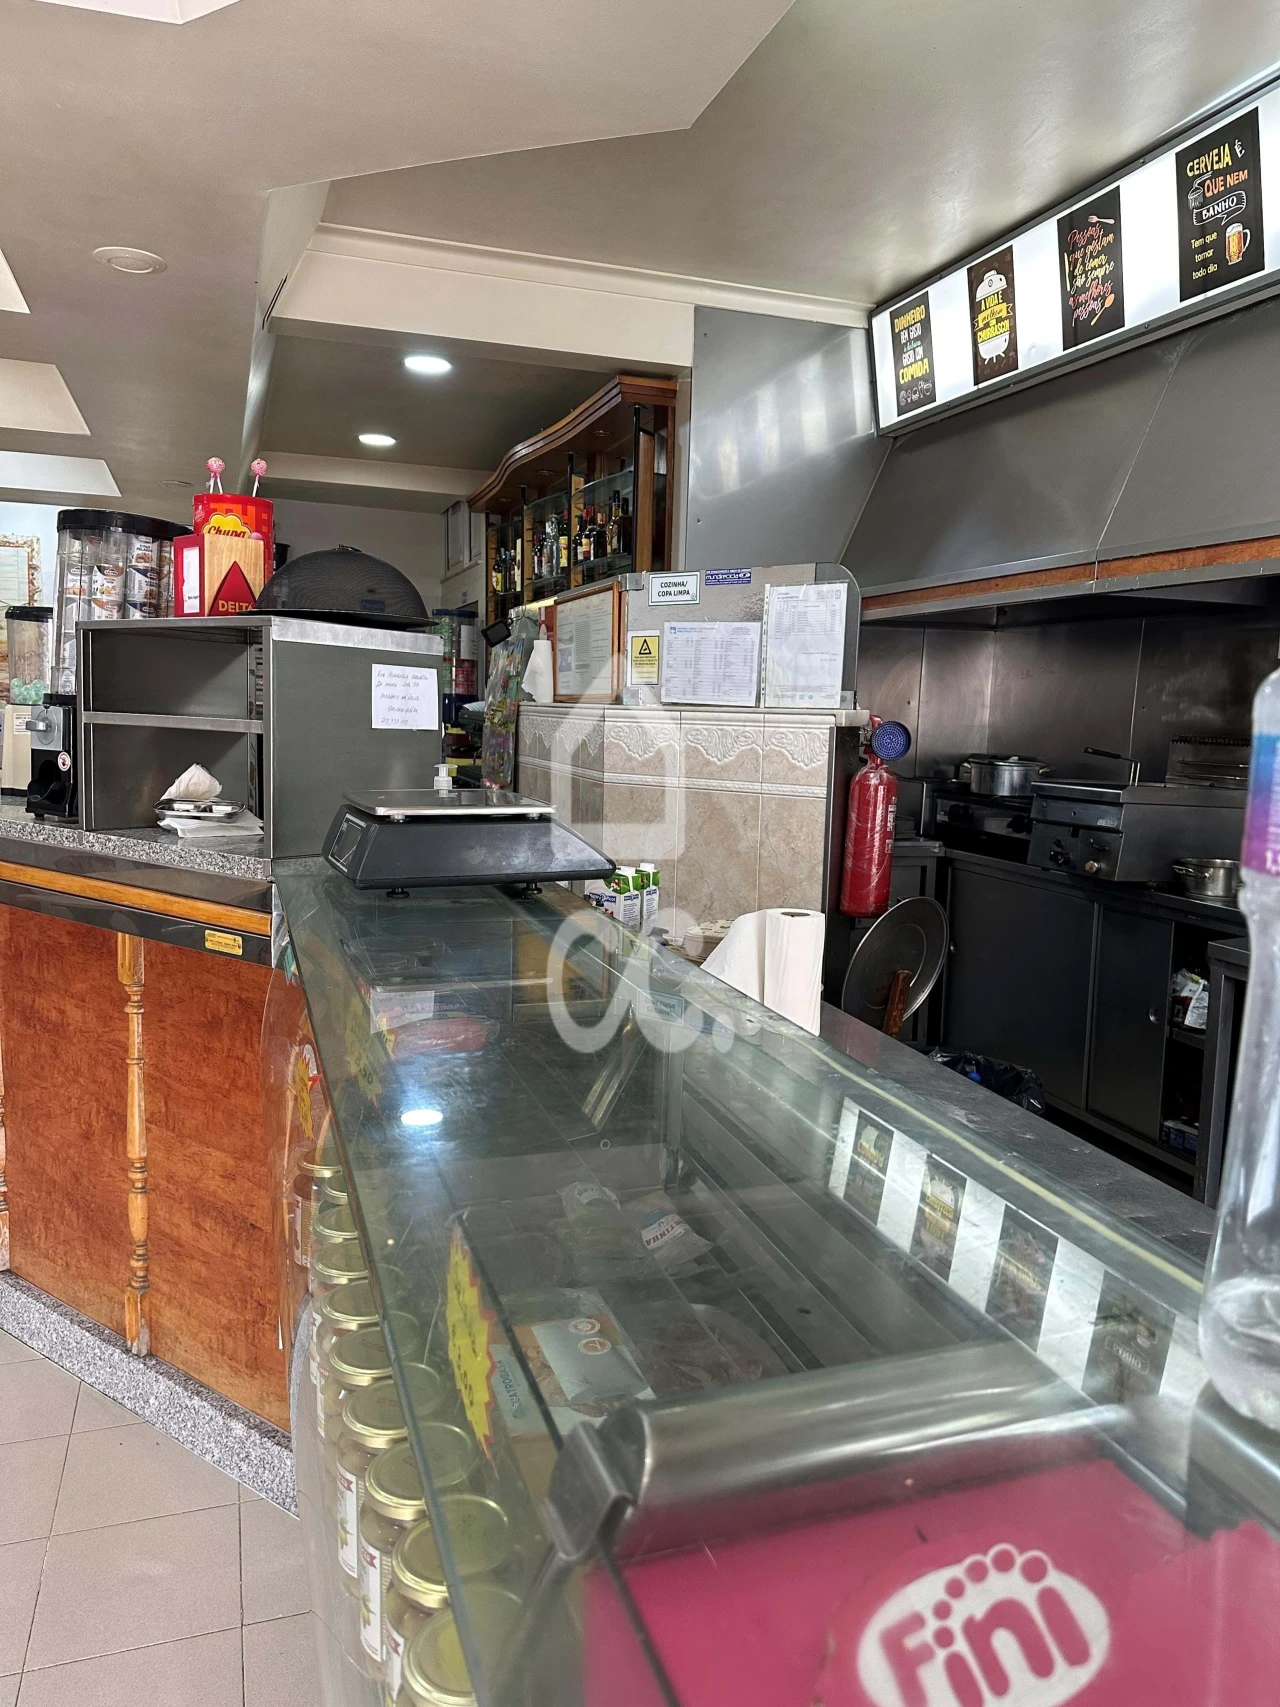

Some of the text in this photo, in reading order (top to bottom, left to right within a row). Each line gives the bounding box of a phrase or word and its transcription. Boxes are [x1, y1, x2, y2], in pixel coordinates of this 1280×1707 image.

[1186, 139, 1245, 178] CERVEJA É
[1204, 169, 1248, 198] QUE NEM
[1202, 195, 1236, 220] BANHO
[1068, 223, 1102, 250] Pessoas
[1190, 231, 1218, 249] Tem que
[1069, 229, 1115, 271] que gostam
[1194, 248, 1214, 262] tomar
[1074, 253, 1108, 276] de comer
[1086, 260, 1115, 288] sempre
[1192, 262, 1218, 279] todo dia
[981, 299, 986, 311] A
[985, 293, 999, 309] VIDA
[1079, 279, 1113, 302] melhores
[894, 304, 926, 333] DINHEIRO
[1072, 296, 1103, 327] pessoas
[900, 322, 922, 344] BEM GASTO
[902, 349, 914, 367] GASTO
[899, 358, 930, 385] COMIDA
[207, 525, 247, 538] Chupa
[657, 589, 691, 597] COPA LIMPA
[660, 580, 688, 588] COZINHA/
[218, 600, 253, 613] DELTA
